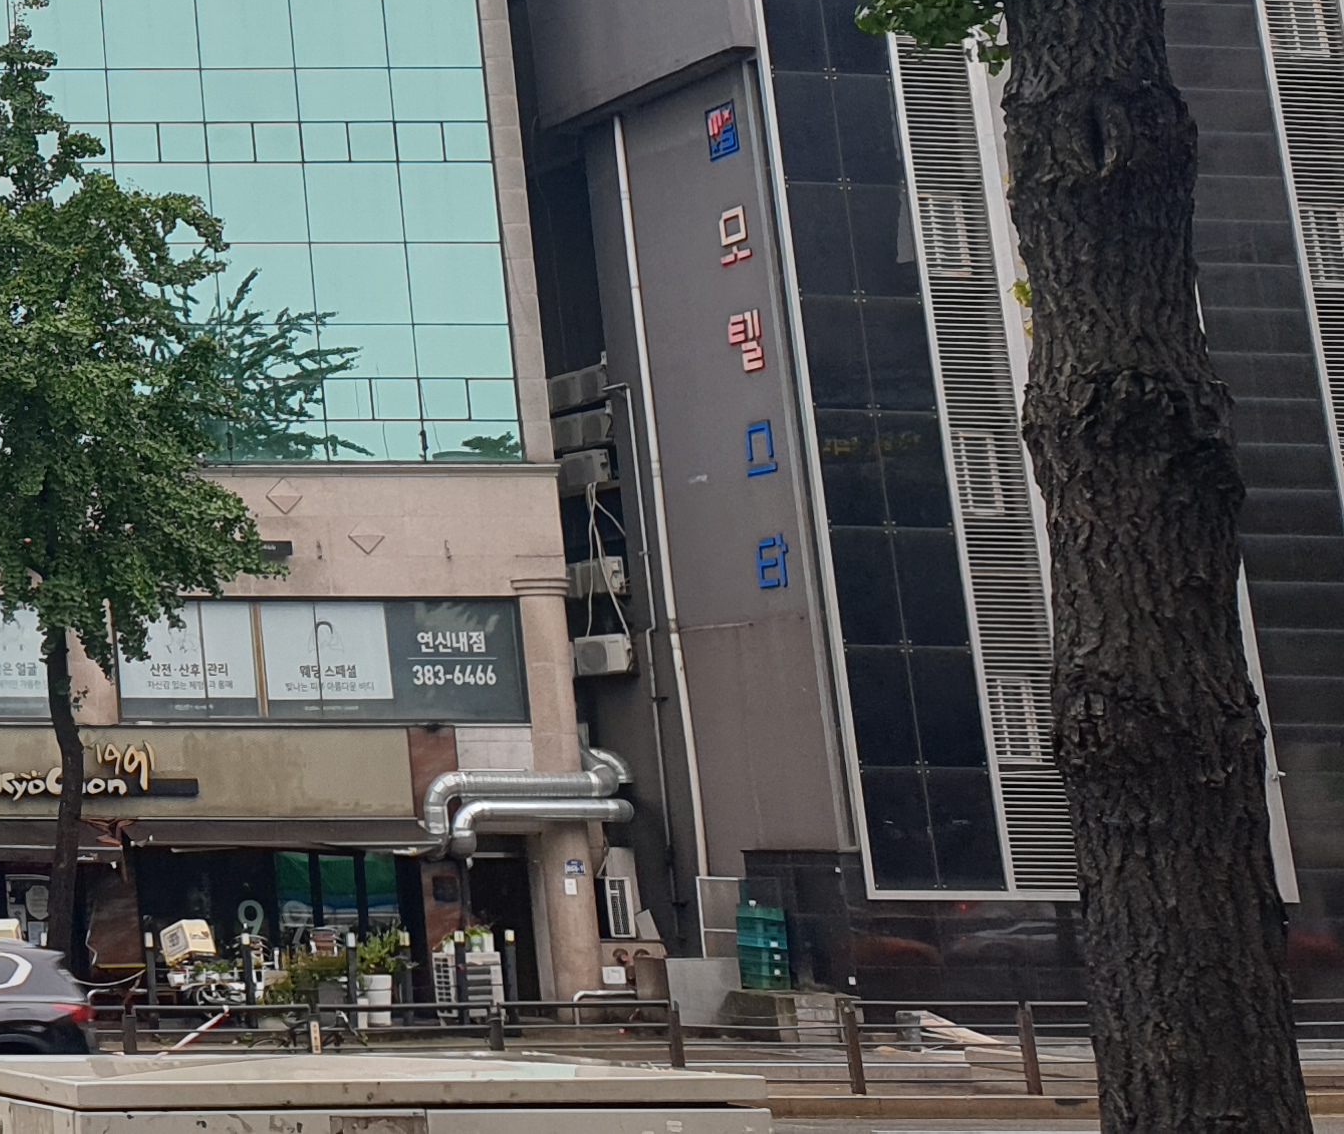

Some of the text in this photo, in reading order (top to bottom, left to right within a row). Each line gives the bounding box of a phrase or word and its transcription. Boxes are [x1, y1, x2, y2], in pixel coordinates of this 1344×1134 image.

[416, 631, 487, 654] 연신내점
[206, 662, 229, 677] 관리
[412, 665, 497, 686] 383-6466
